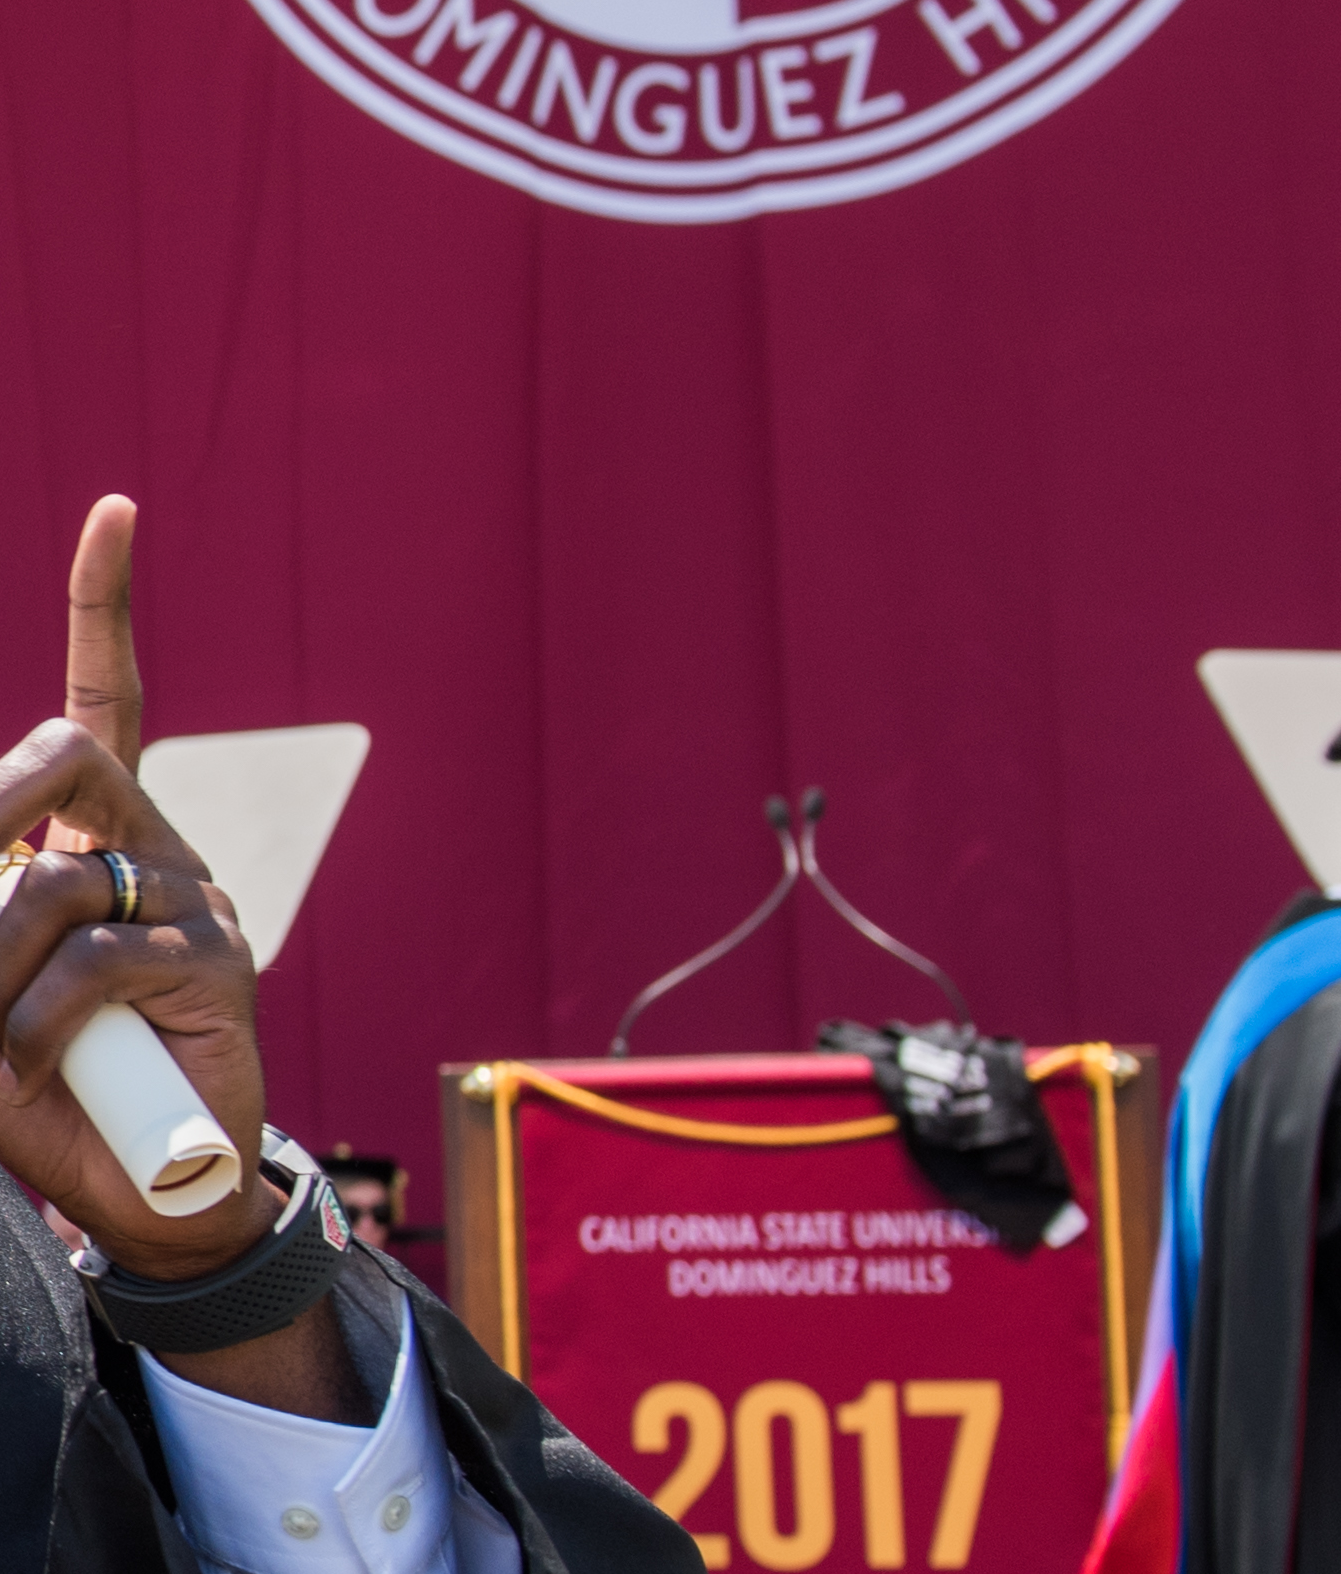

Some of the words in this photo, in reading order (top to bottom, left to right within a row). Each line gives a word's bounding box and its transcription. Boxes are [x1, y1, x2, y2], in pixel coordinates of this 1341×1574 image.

[579, 1213, 760, 1254] CALIFORNIA
[761, 1210, 848, 1252] STATE
[667, 1255, 860, 1298] DOMINGUEZ
[862, 1253, 953, 1295] HILLS
[632, 1380, 1003, 1572] 2017
